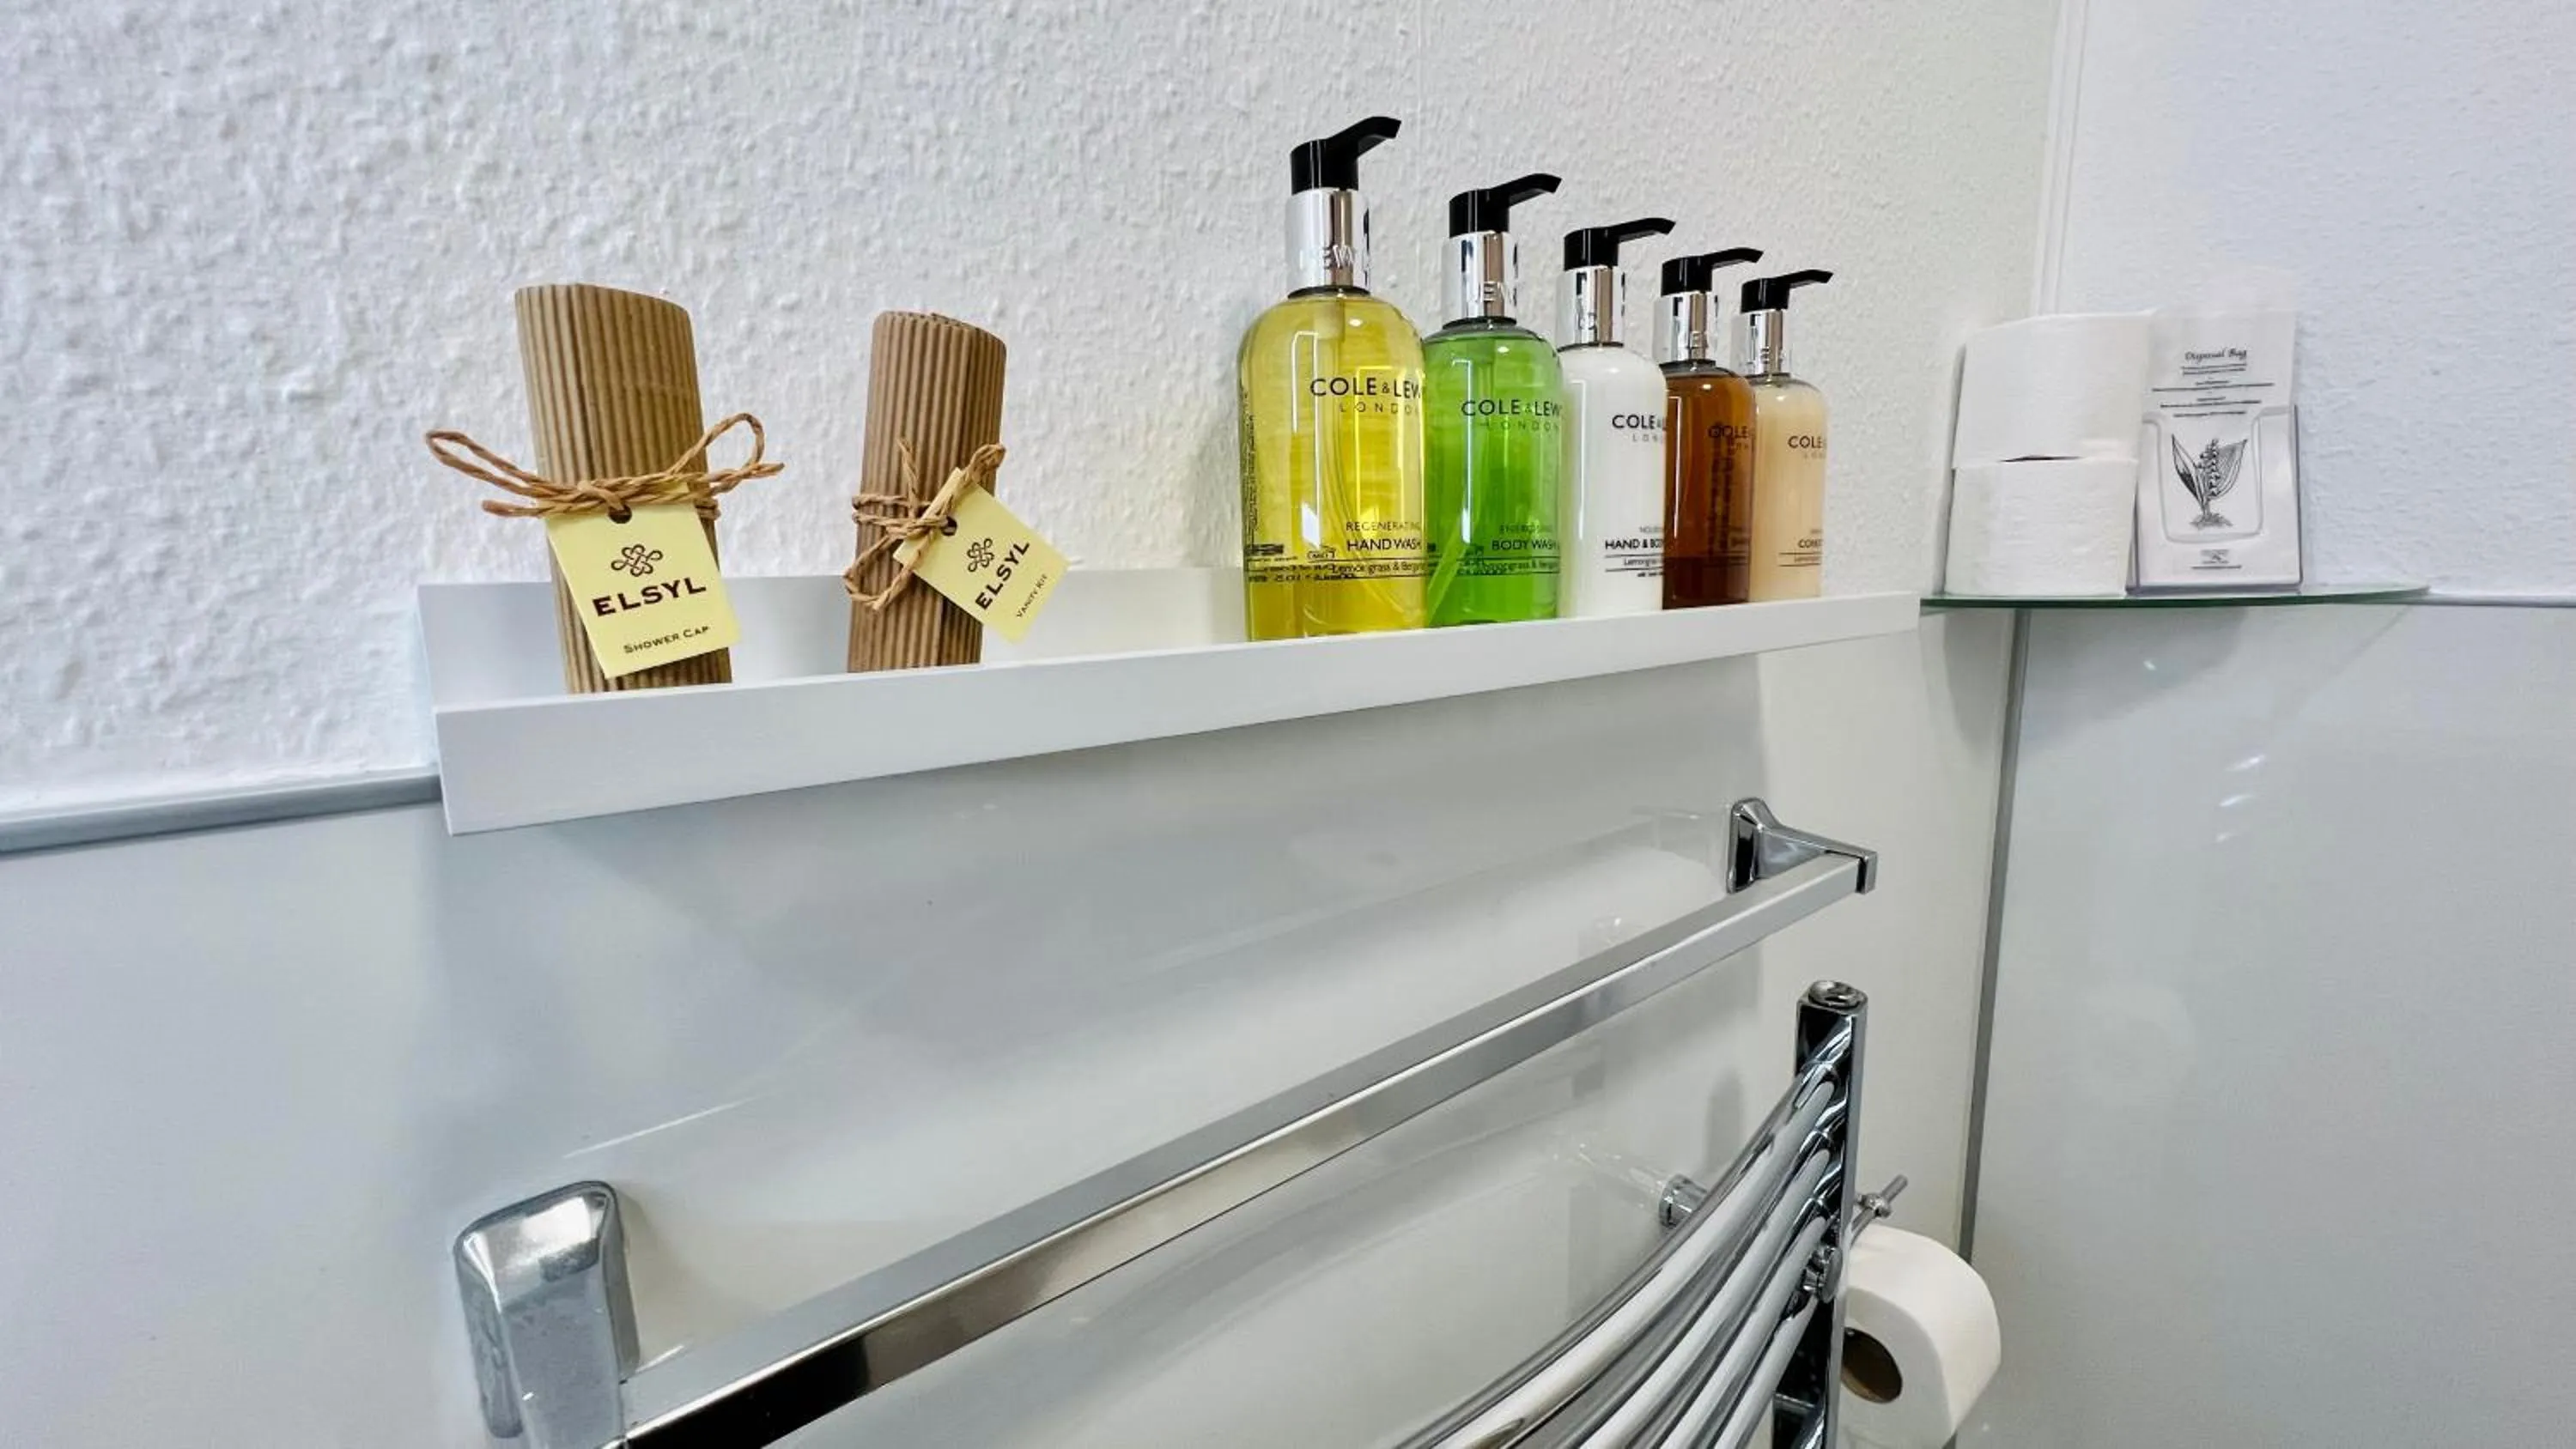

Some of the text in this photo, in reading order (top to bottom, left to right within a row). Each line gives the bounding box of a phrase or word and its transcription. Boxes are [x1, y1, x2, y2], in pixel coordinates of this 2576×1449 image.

[1310, 377, 1421, 400] COLE & LEW
[1340, 400, 1419, 415] LONDO
[1461, 398, 1522, 415] COLE
[1534, 401, 1562, 416] LEW
[1613, 415, 1655, 429] COLE
[1346, 538, 1391, 551] HAND
[1605, 539, 1641, 549] HAND
[975, 542, 1030, 609] ELSYL
[592, 577, 706, 616] ELSYL
